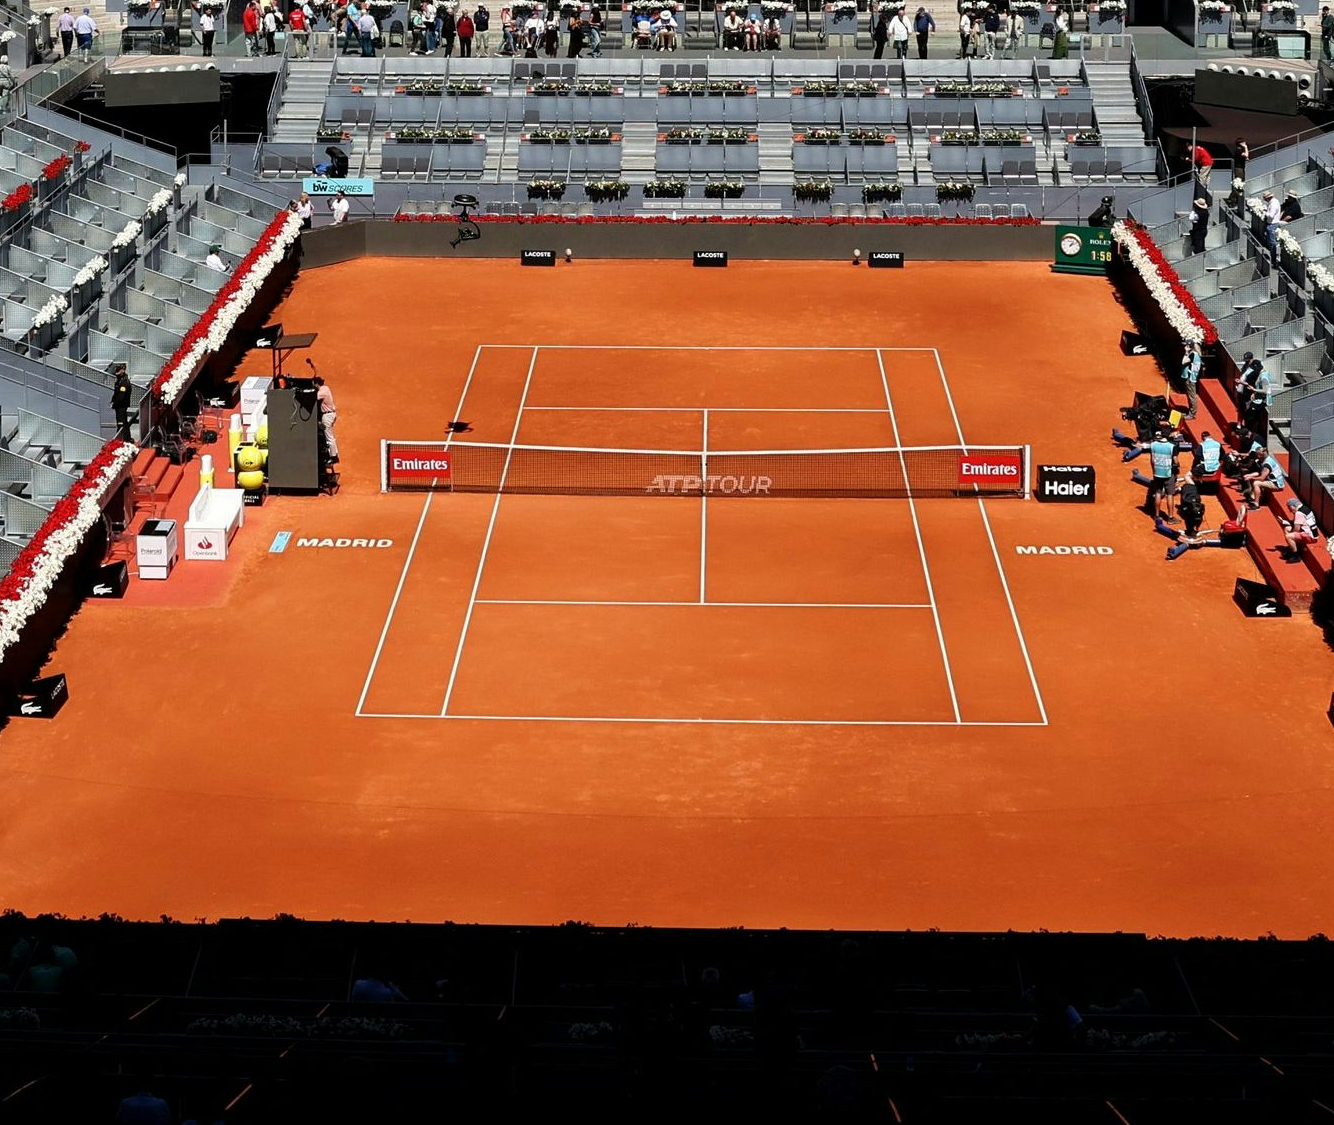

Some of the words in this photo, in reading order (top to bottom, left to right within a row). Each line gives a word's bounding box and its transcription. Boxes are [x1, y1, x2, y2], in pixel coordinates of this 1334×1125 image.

[328, 185, 363, 193] SCORES
[1091, 250, 1112, 261] 1:58
[393, 458, 448, 471] Emirates
[962, 463, 1017, 475] Emirates
[646, 475, 701, 493] ATP
[705, 475, 772, 494] TOUR
[1045, 480, 1090, 496] Haier
[296, 538, 393, 548] MADRID
[1015, 545, 1114, 555] MADRID
